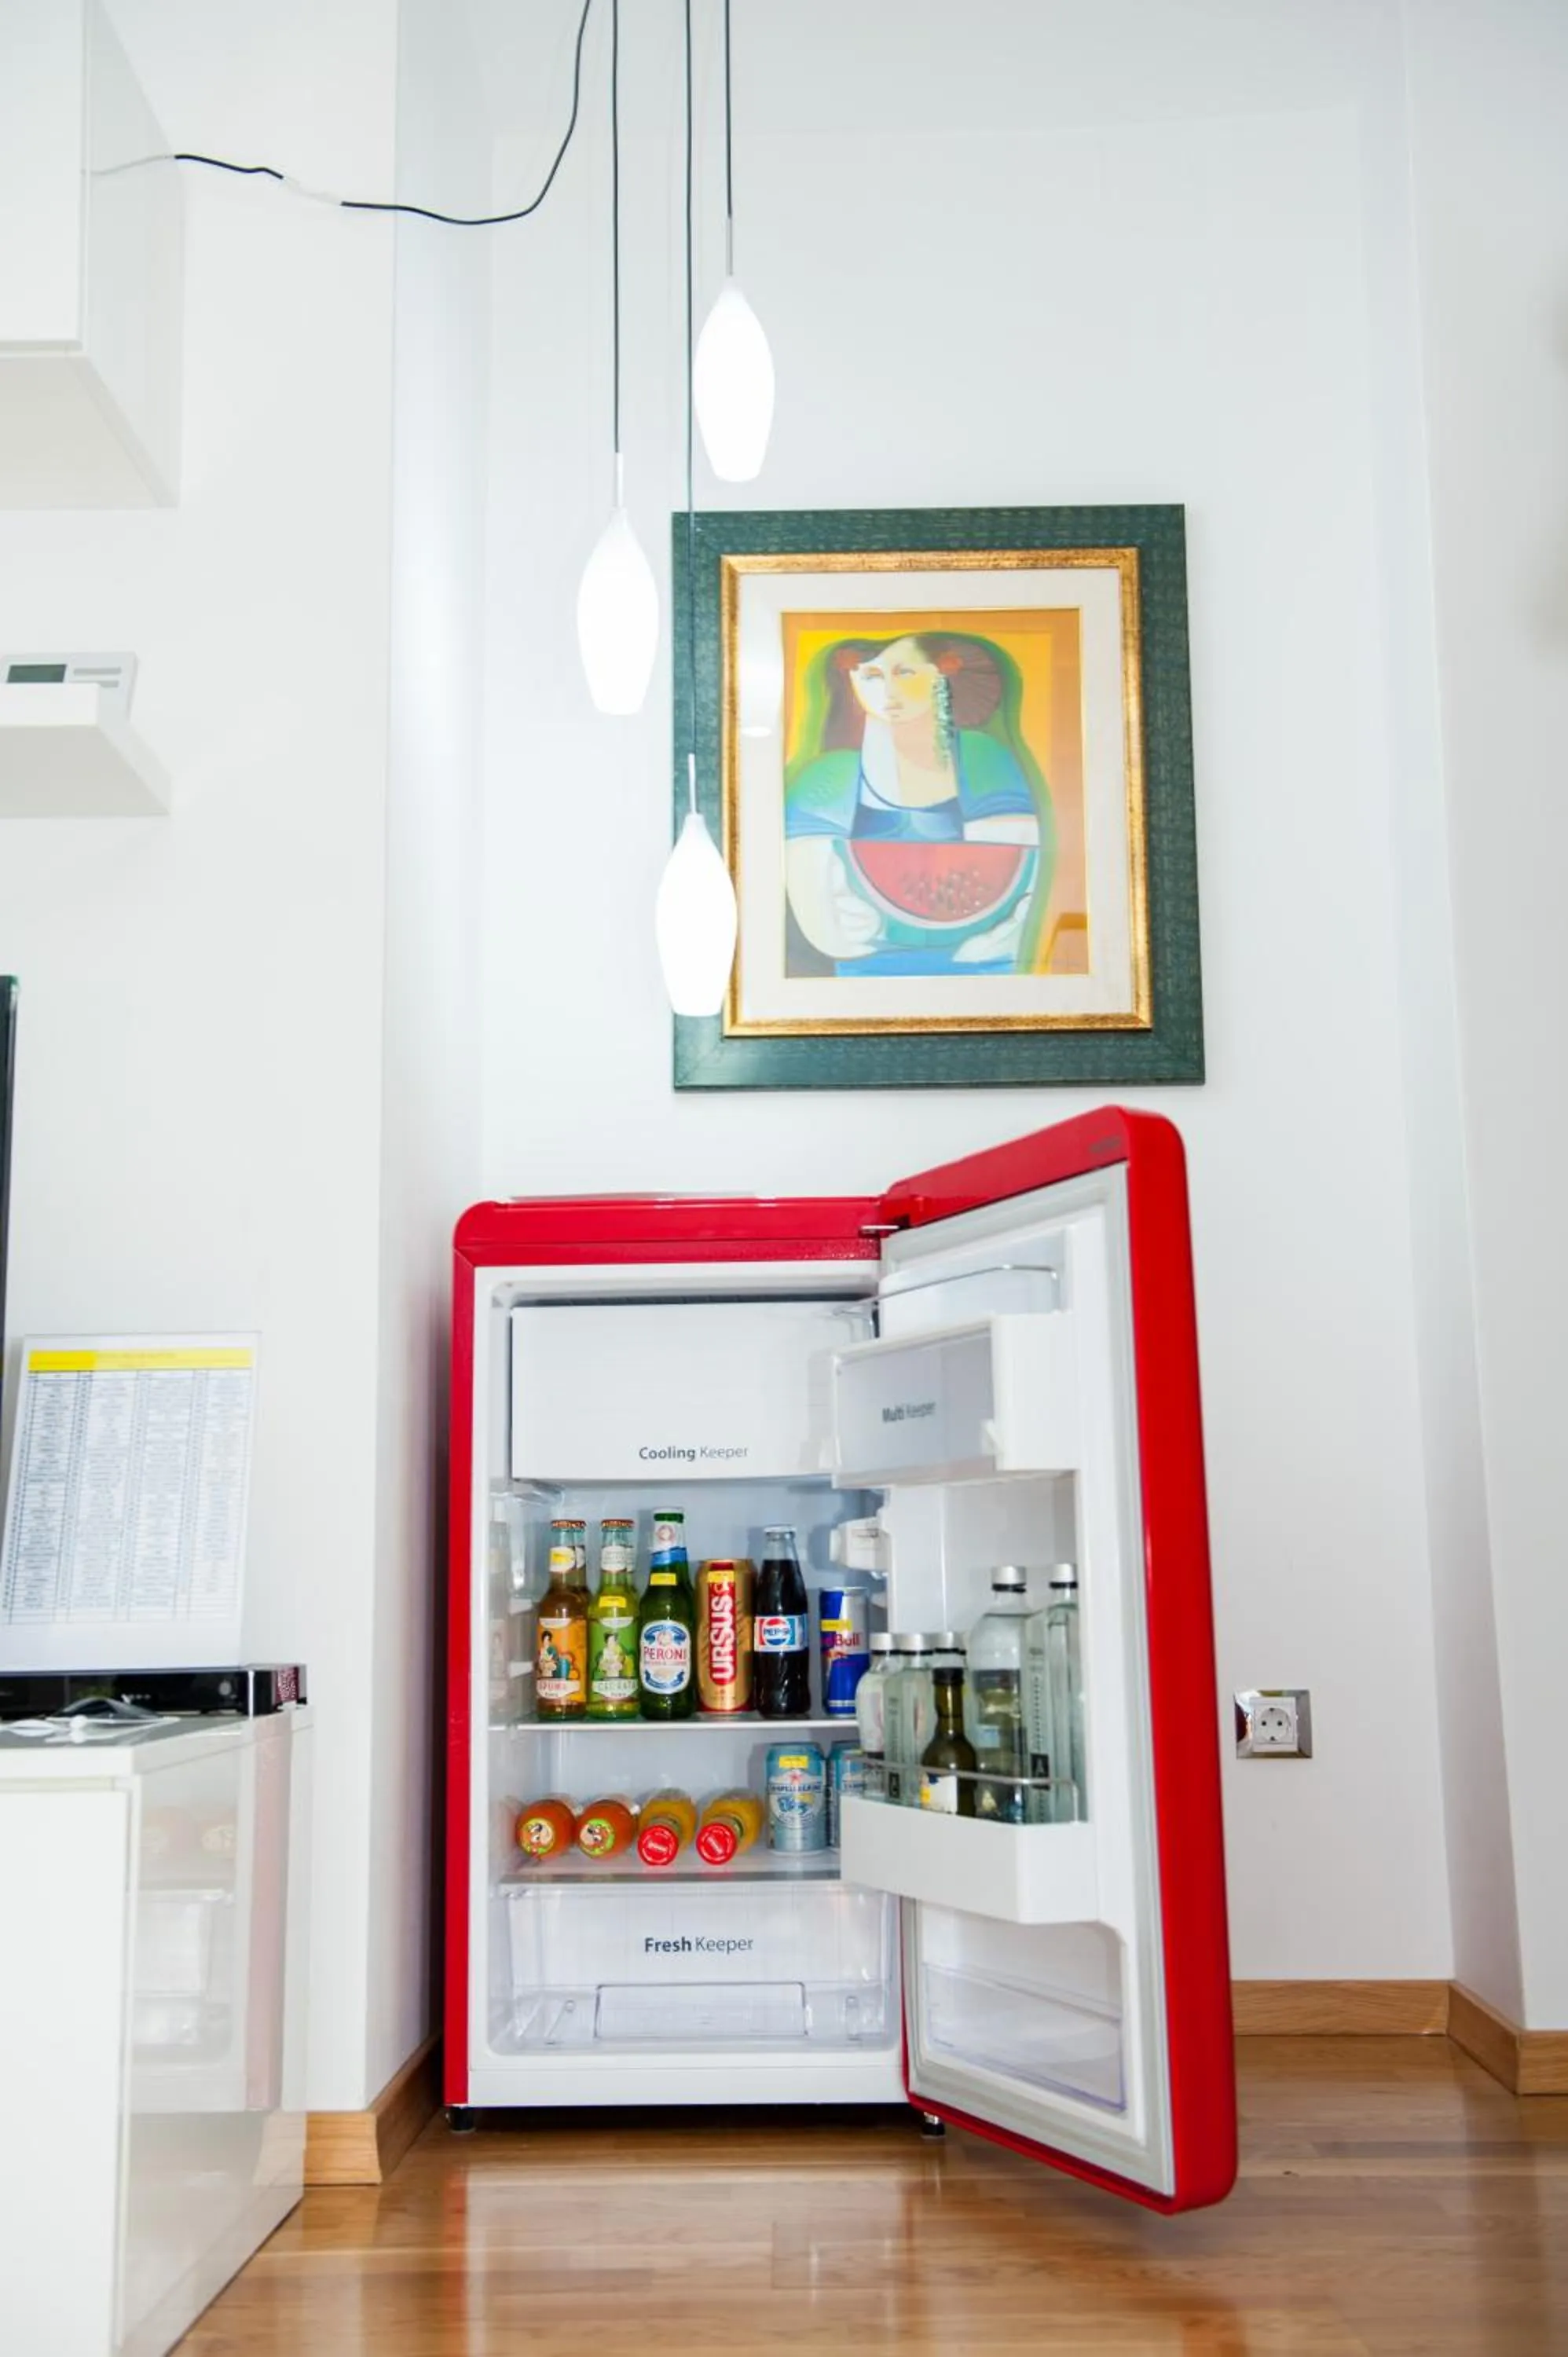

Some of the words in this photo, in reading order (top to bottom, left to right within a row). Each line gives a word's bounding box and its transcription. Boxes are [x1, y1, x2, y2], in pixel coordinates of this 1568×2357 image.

[639, 1446, 696, 1462] Cooling
[700, 1446, 748, 1458] Keeper
[710, 1596, 735, 1680] URSUS
[764, 1627, 790, 1636] PEPSI
[835, 1633, 861, 1647] Bull
[643, 1646, 687, 1660] PERONI
[644, 1936, 692, 1953] Fresh
[695, 1937, 753, 1955] Keeper
